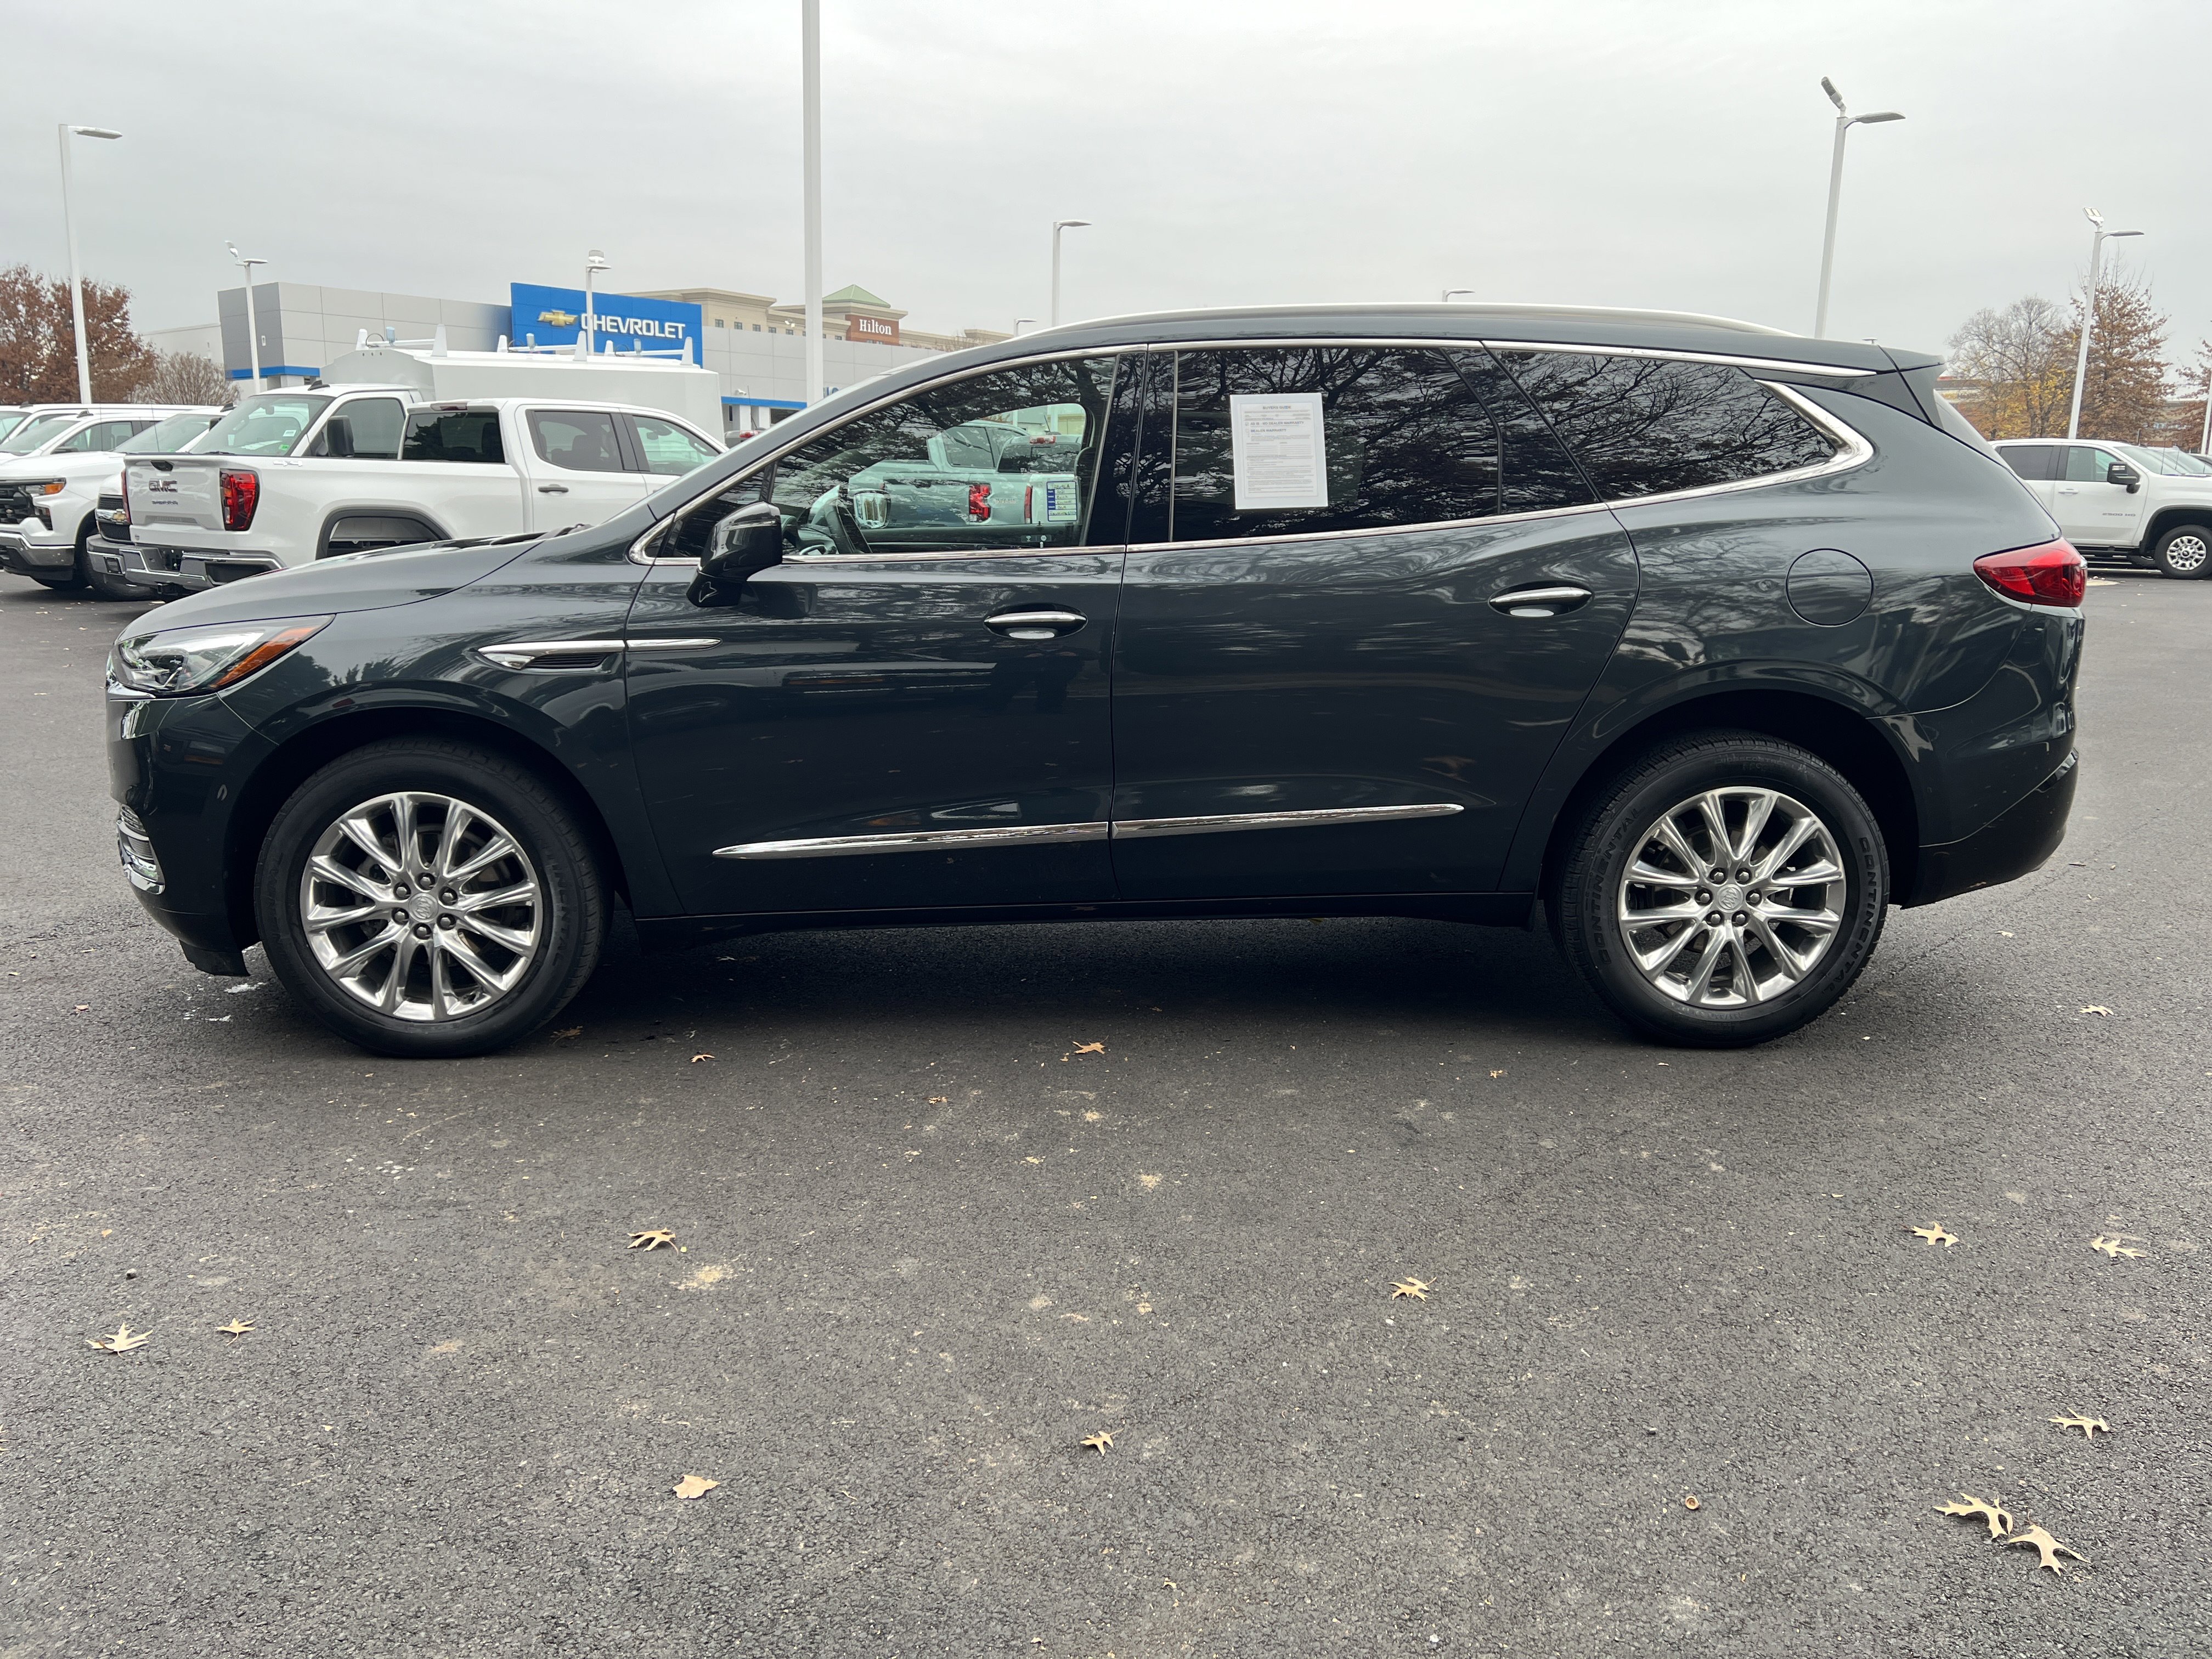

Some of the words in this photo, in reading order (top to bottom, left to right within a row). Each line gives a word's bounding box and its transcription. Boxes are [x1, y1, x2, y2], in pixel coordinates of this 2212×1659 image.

[581, 313, 686, 339] CHEVROLET
[859, 319, 892, 335] Hilton
[149, 479, 178, 493] GMC
[1590, 806, 1643, 965] CONTINENTAL
[1820, 837, 1877, 994] CONTINENTAL
